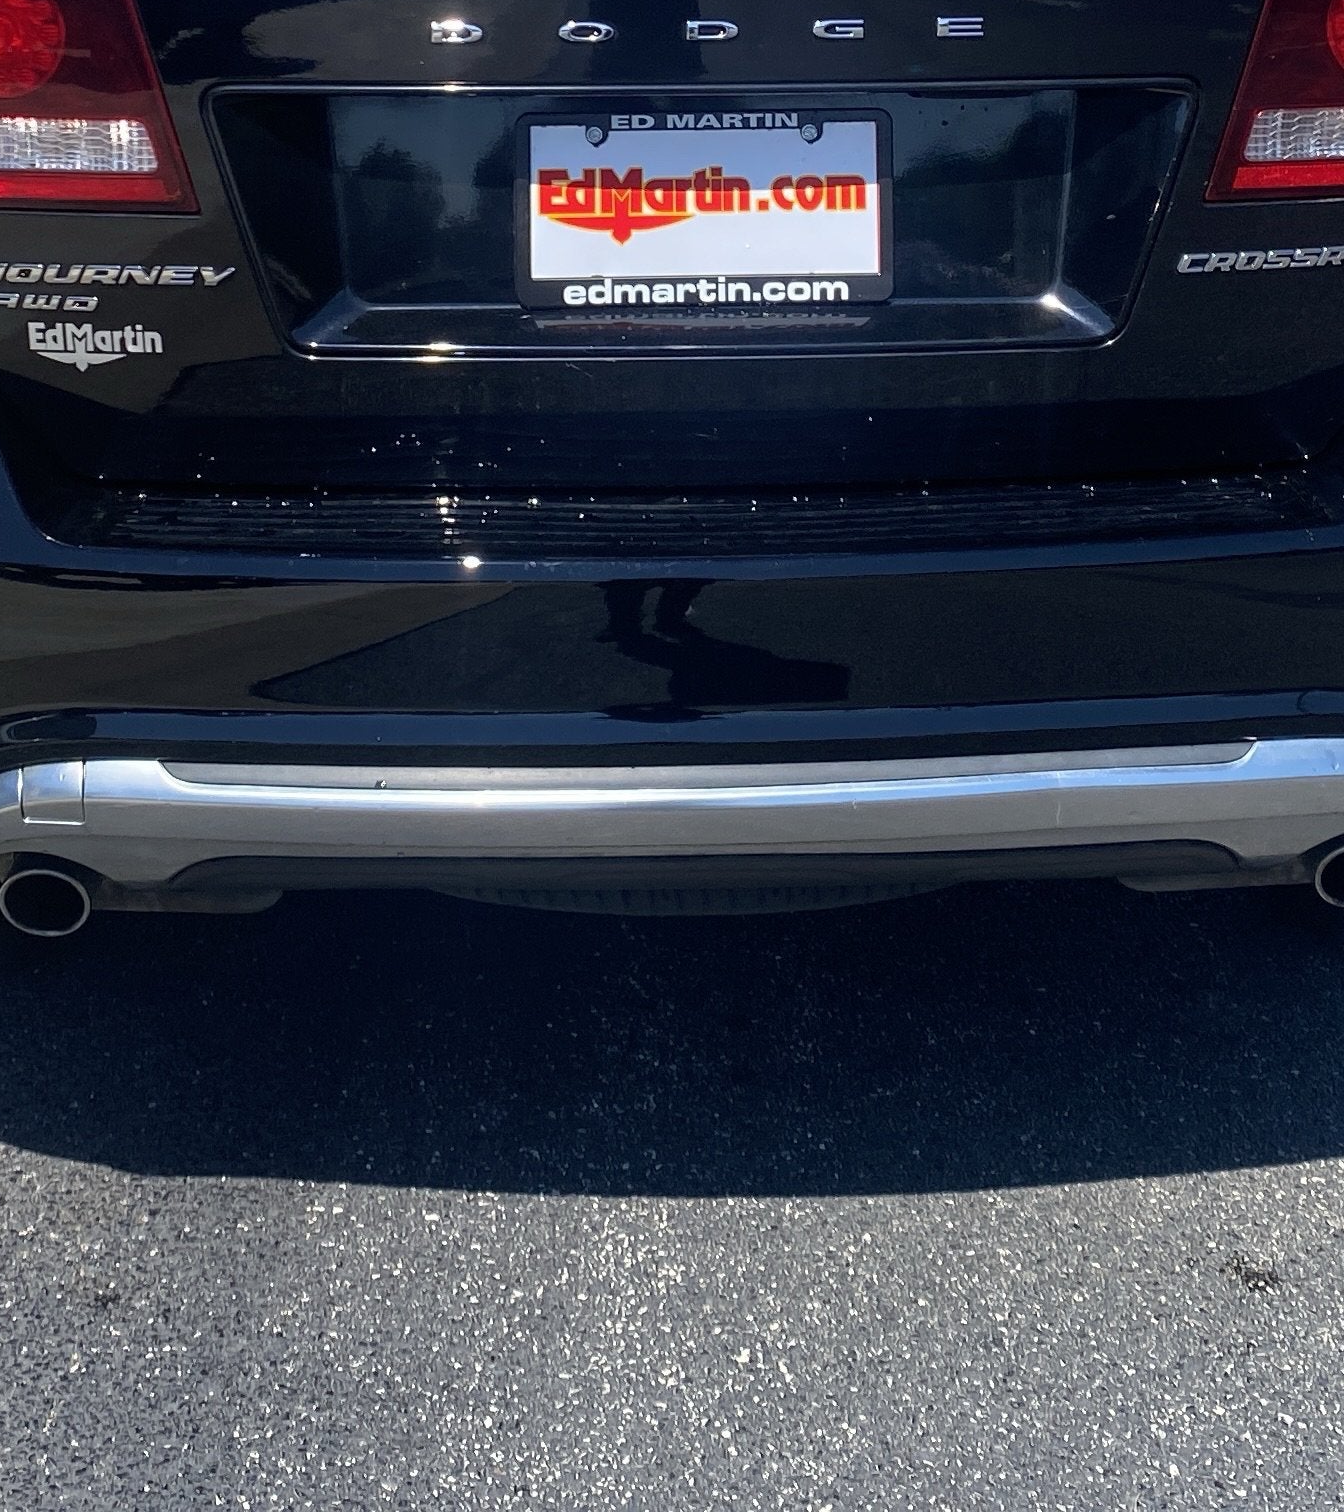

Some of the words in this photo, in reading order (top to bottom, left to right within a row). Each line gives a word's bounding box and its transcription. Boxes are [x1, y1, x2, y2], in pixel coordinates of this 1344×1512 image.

[430, 15, 985, 44] DODGE
[611, 114, 655, 130] ED
[666, 112, 798, 129] MARTIN
[537, 166, 868, 215] EdMartin.com
[562, 276, 850, 305] edmartin.com
